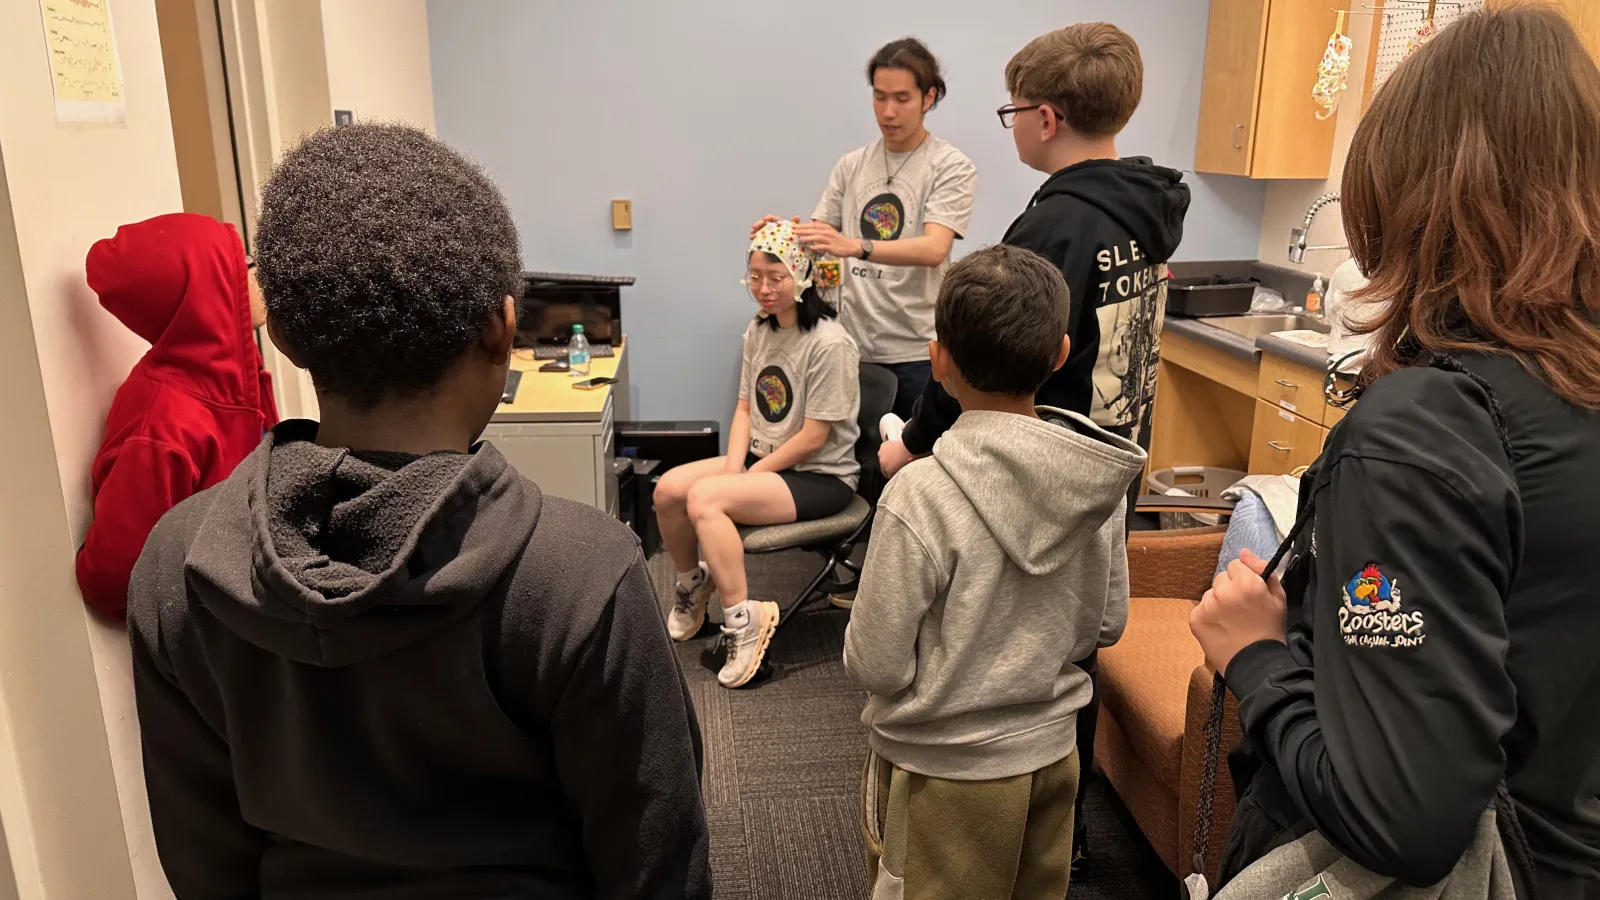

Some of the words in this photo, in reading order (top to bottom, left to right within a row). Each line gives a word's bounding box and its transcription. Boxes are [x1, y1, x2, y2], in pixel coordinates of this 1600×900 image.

[1096, 239, 1147, 272] SLE
[1338, 606, 1424, 635] Roosters
[1390, 634, 1427, 648] JOINT
